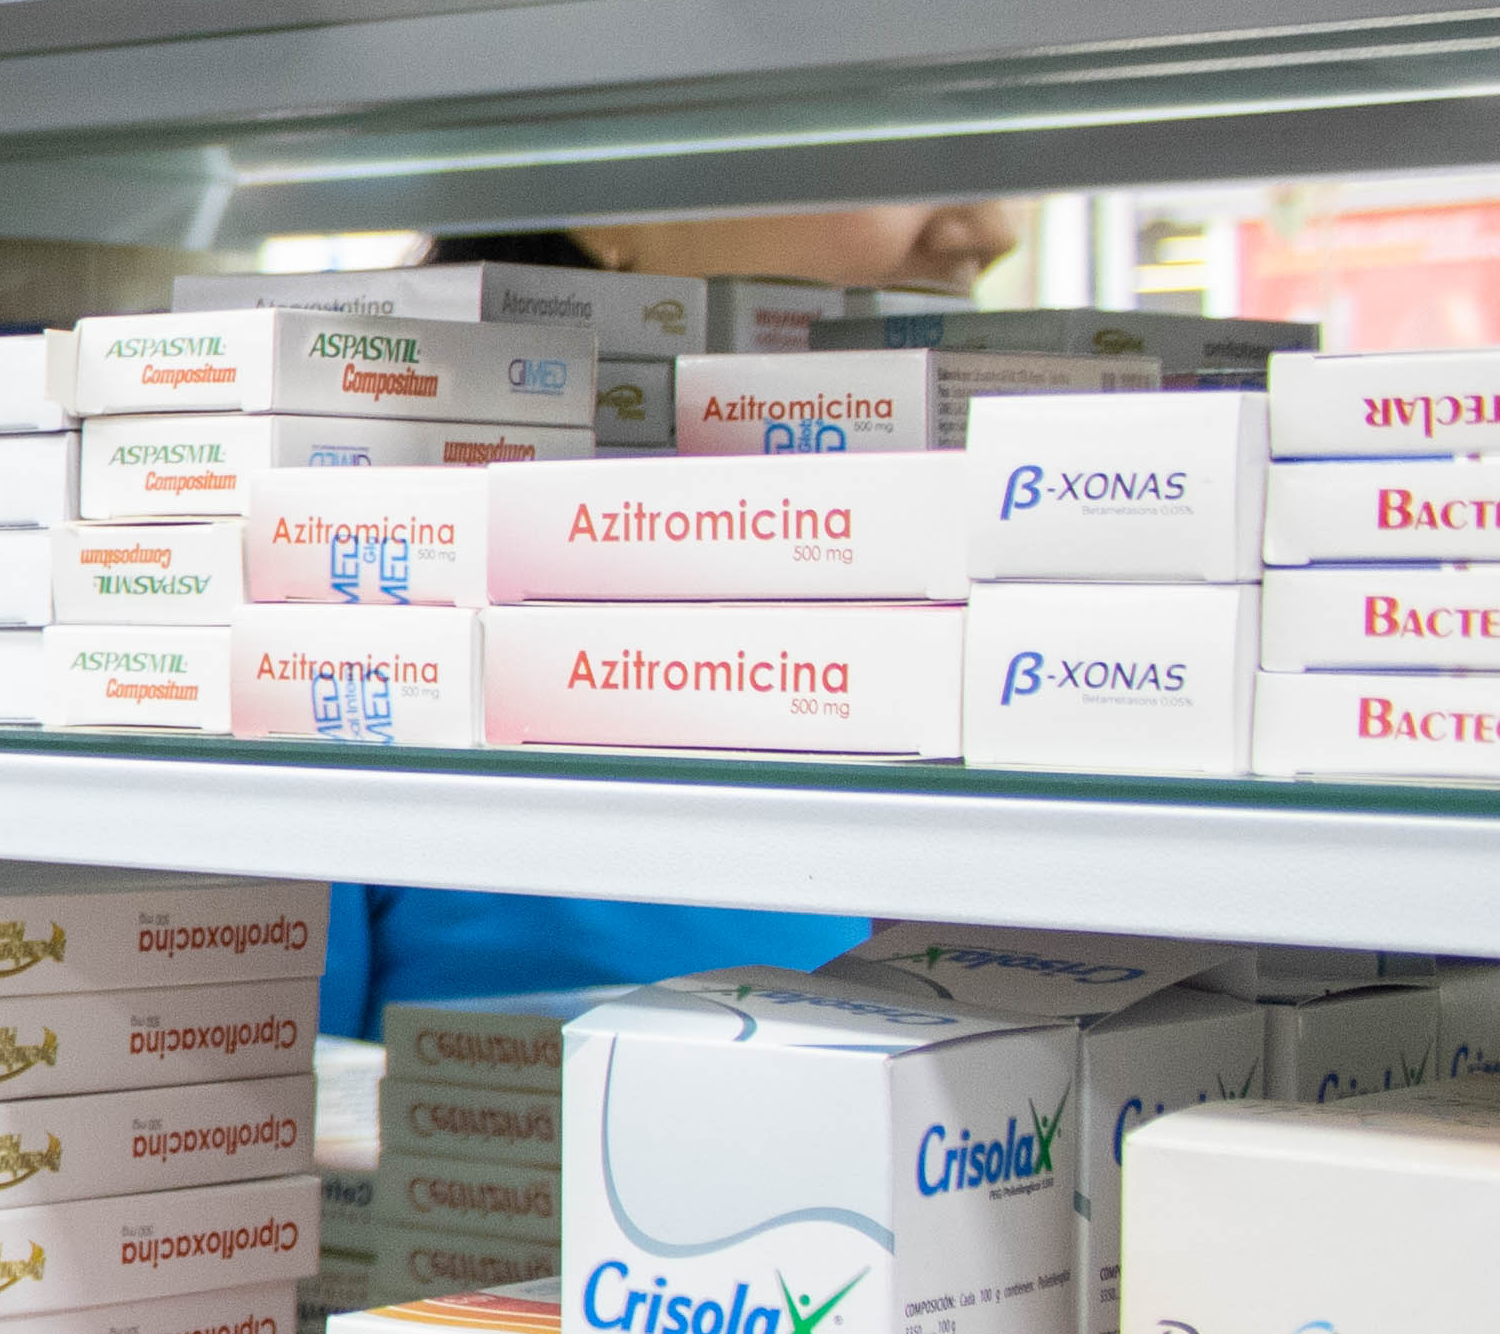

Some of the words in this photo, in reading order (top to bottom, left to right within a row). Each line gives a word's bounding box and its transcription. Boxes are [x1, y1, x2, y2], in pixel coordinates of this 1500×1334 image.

[341, 363, 439, 401] Compositum
[272, 516, 456, 547] Azitromicina
[568, 497, 852, 544] Azitromicina
[80, 546, 172, 568] Compositum
[793, 546, 821, 563] 500
[825, 548, 852, 567] mg
[139, 919, 309, 953] Ciprofloxacina
